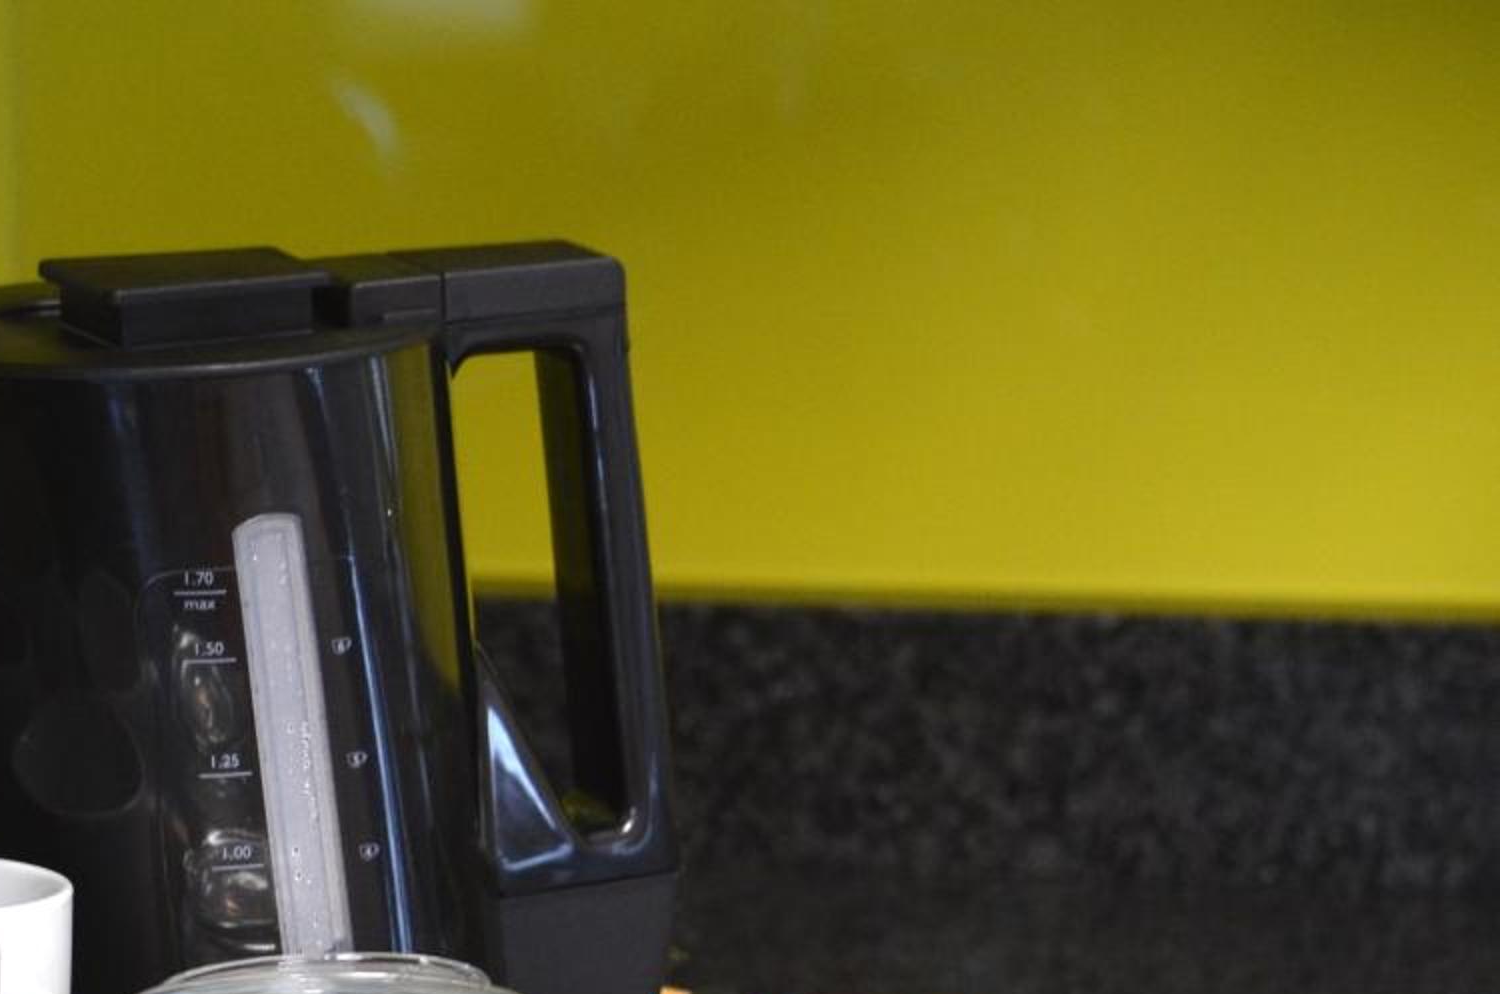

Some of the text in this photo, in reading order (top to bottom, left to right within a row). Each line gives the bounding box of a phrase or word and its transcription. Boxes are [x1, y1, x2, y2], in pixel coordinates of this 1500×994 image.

[183, 570, 214, 586] 1.70
[211, 753, 240, 768] 1.25
[223, 845, 251, 860] 1.00
